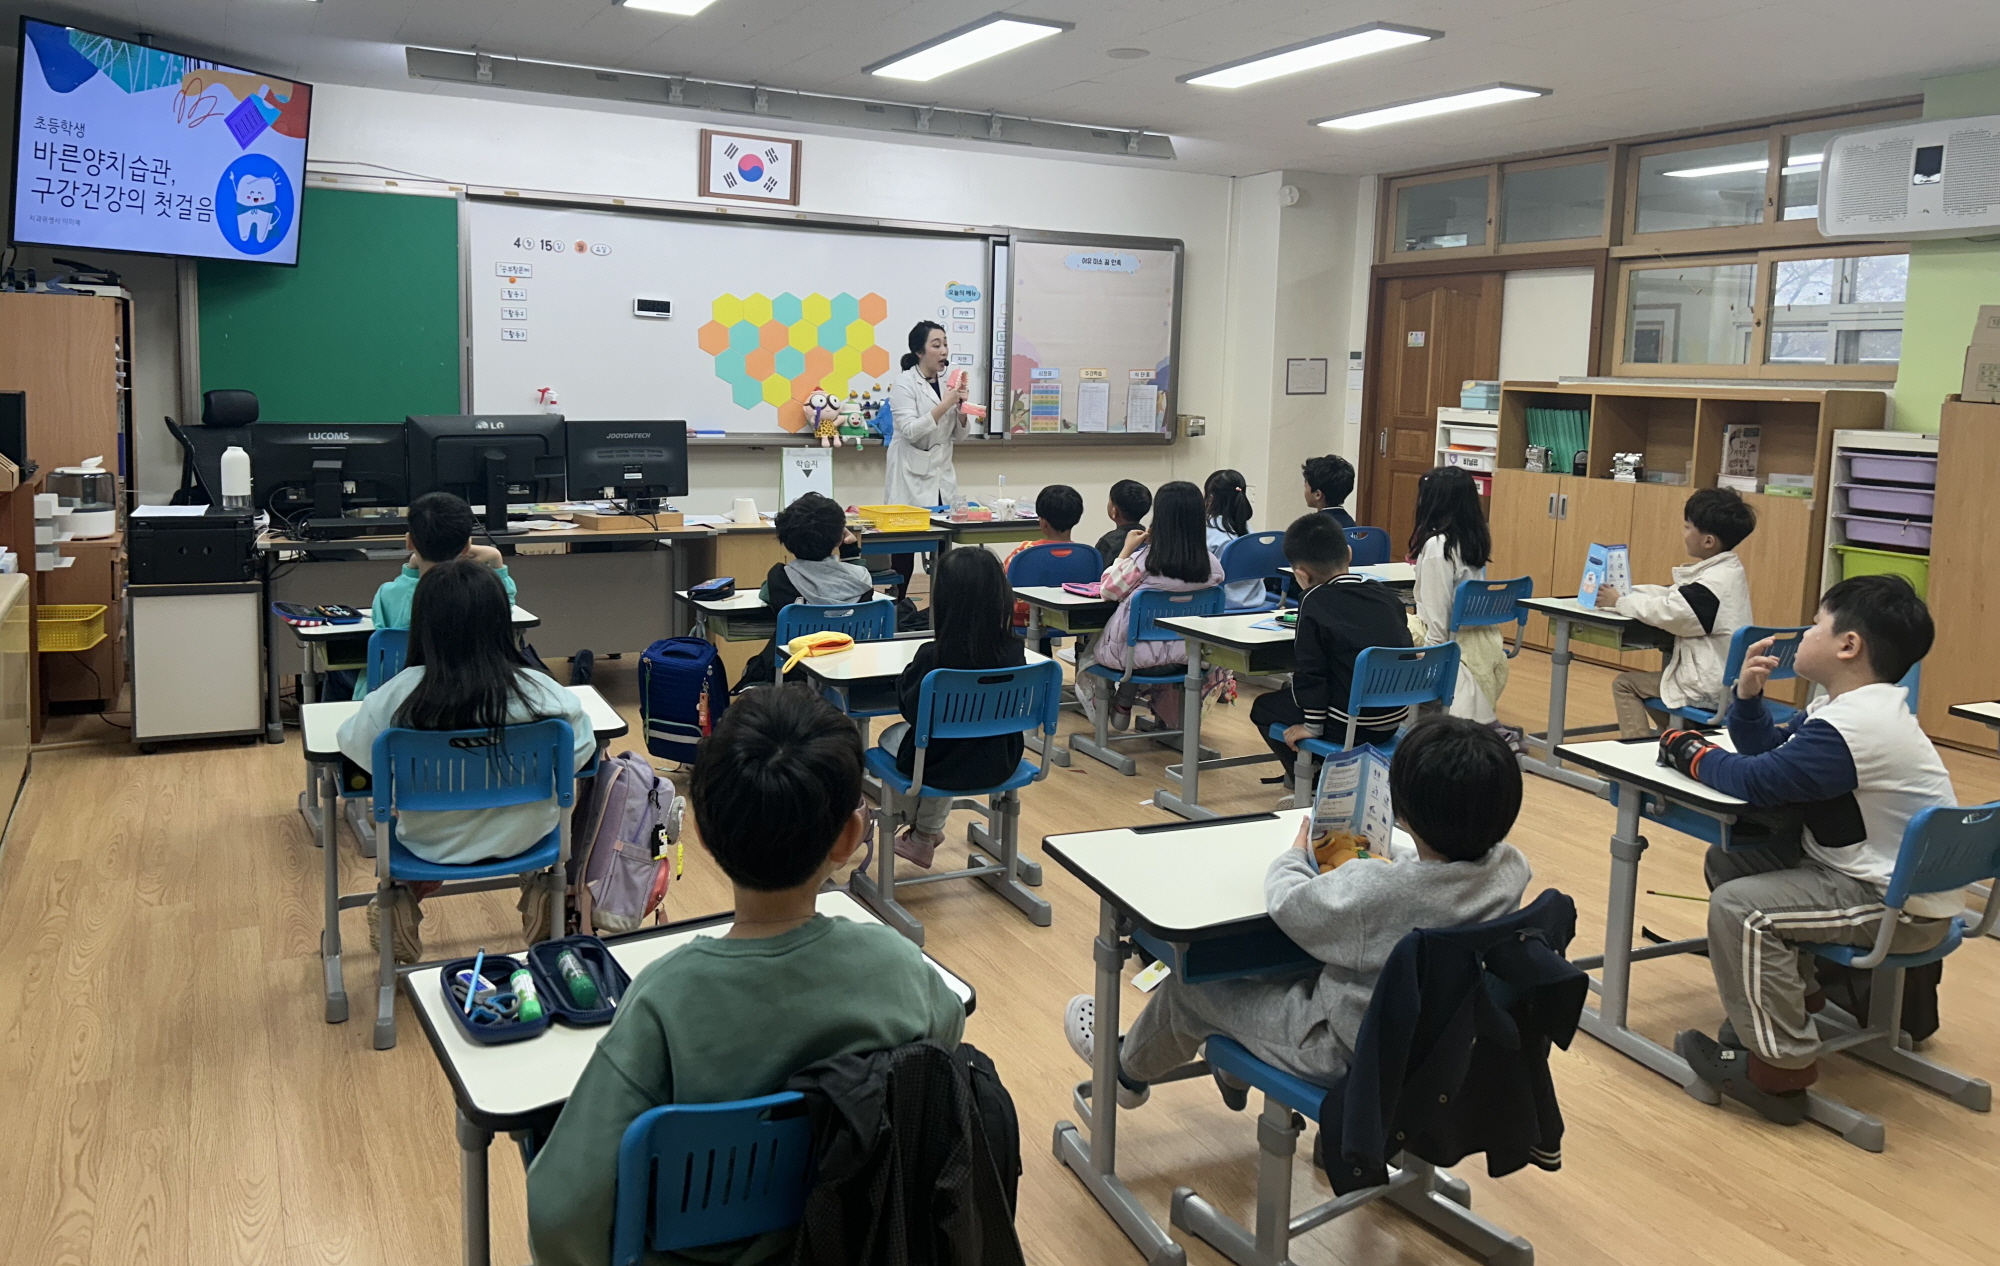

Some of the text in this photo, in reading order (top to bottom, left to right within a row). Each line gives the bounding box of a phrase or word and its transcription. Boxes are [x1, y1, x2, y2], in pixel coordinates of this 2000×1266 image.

[33, 115, 86, 139] 초등학생
[33, 140, 176, 187] 바른양치습관,
[30, 176, 215, 223] 구강건강의 첫걸음
[513, 237, 521, 248] 4
[540, 238, 553, 252] 15
[490, 421, 505, 430] LG
[308, 431, 350, 441] LUCOMS
[606, 432, 651, 440] JOOYONTECH
[795, 459, 818, 469] 학습지
